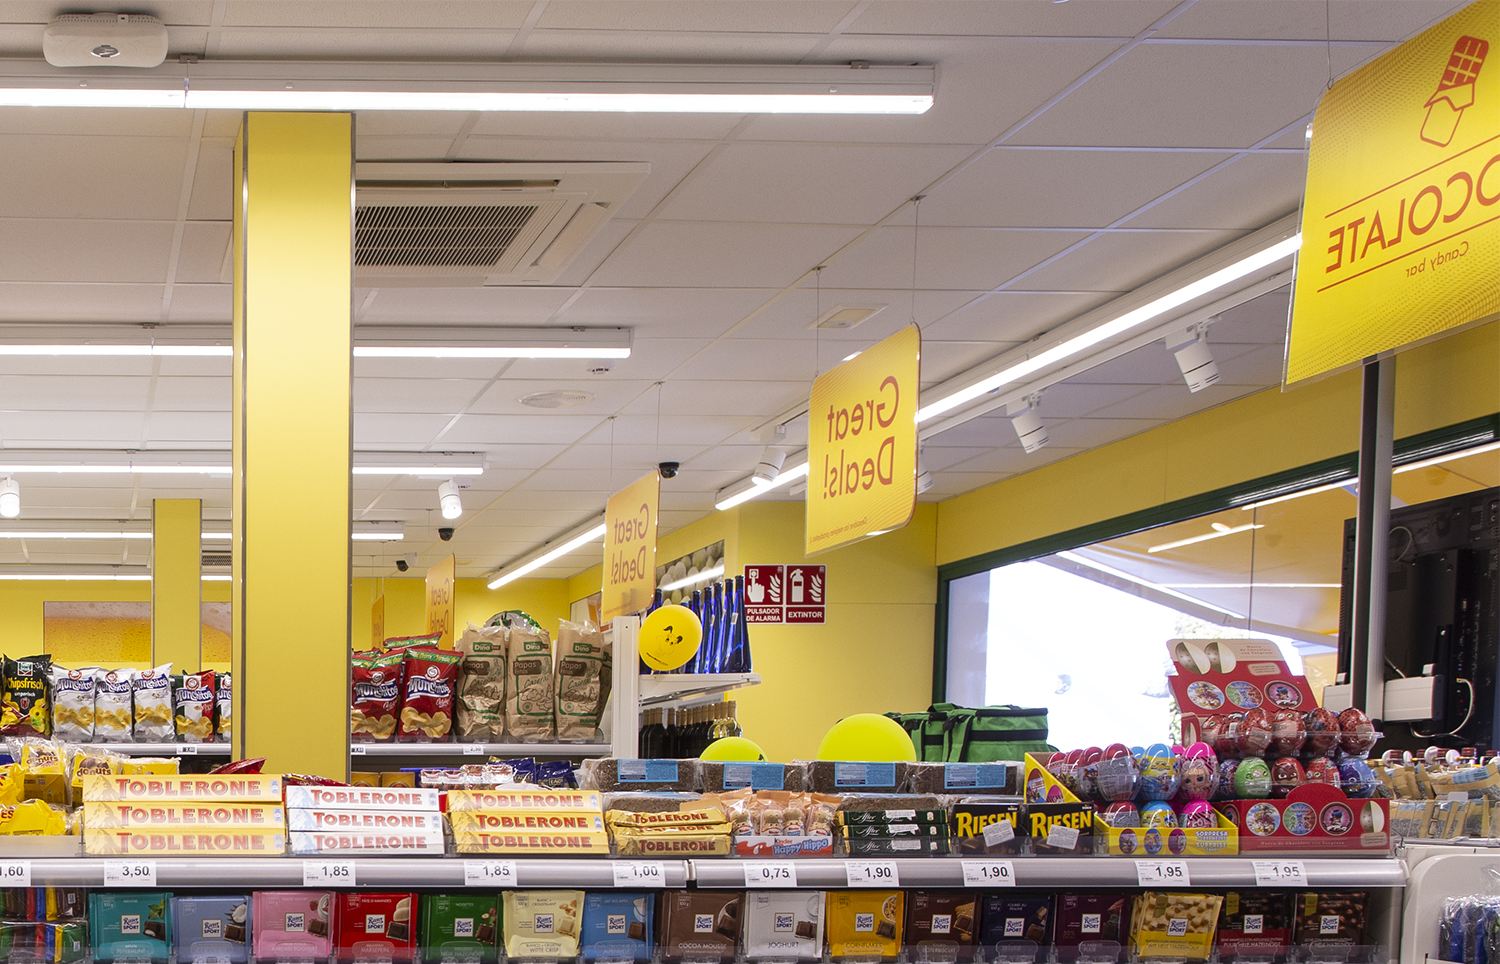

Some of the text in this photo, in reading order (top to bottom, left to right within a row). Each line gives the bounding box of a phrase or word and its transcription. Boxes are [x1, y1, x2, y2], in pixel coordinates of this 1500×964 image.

[116, 778, 261, 799] TOBLERONE
[310, 788, 423, 809] TOBLERONE
[472, 793, 584, 809] TOBLERONE
[118, 806, 265, 826] TOBLERONE
[116, 832, 265, 852] TOBLERONE
[802, 838, 829, 851] Hippo
